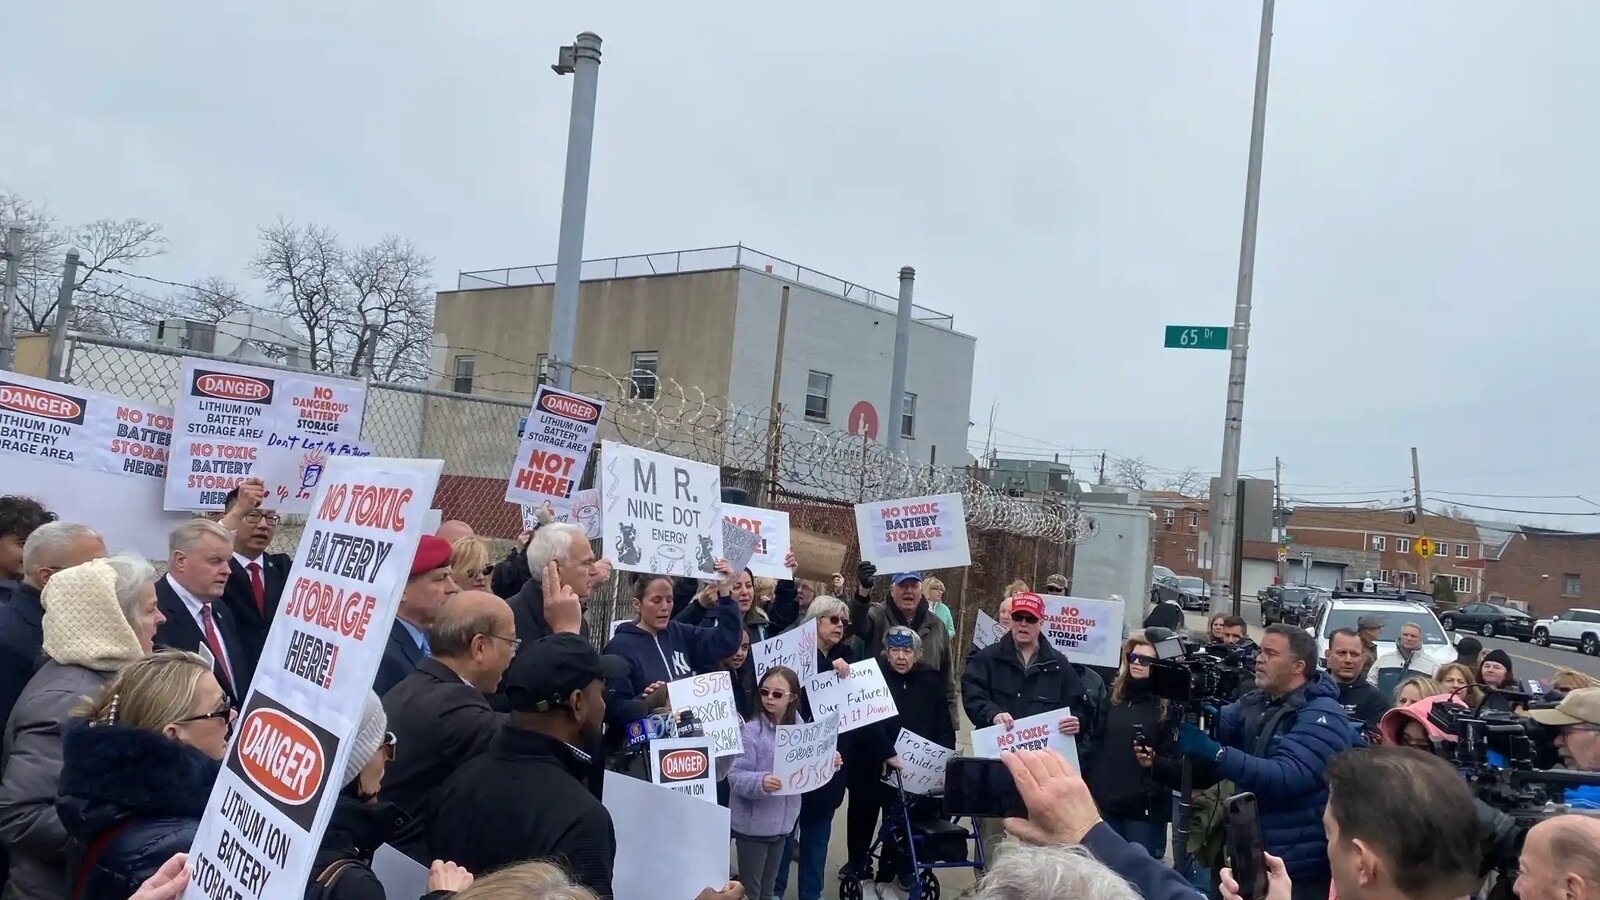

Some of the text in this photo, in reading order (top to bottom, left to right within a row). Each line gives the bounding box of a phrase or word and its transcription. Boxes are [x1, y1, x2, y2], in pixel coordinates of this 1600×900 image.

[1180, 328, 1213, 345] 65 Dr
[205, 378, 263, 397] DANGER
[314, 386, 333, 400] NO
[0, 388, 72, 416] DANGER
[199, 401, 262, 416] LITHIUM ION
[292, 397, 349, 413] DANGEROUS
[547, 396, 592, 418] DANGER
[117, 406, 143, 423] NO
[147, 412, 174, 431] TOX
[207, 413, 252, 426] BATTERY
[300, 409, 339, 422] BATTERY
[0, 413, 71, 436] ITHIUM ION
[188, 423, 237, 437] STORAGE
[297, 419, 339, 432] STORAGE
[540, 415, 588, 434] LITHIUM ION
[1, 427, 58, 446] BATTERY
[117, 423, 172, 447] BATTE
[544, 426, 579, 441] BATTERY
[111, 439, 170, 462] STORA
[528, 432, 587, 453] STORAGE AREA
[41, 446, 74, 461] AREA
[190, 443, 258, 460] NO TOXIC
[192, 459, 253, 475] BATTERY
[528, 448, 575, 477] NOT
[188, 474, 251, 490] STORAG
[515, 468, 575, 499] HERE!
[200, 491, 230, 505] HER
[317, 483, 414, 532] NO TOXIC
[627, 498, 701, 529] NINE DOT
[881, 502, 939, 519] NO TOXIC
[885, 515, 938, 531] BATTERY
[651, 528, 688, 544] ENERGY
[885, 526, 942, 543] STORAGE
[898, 540, 932, 553] HERE!
[304, 530, 393, 584] BATTERY
[285, 576, 376, 641] STORAGE
[1061, 606, 1079, 617] NO
[1043, 615, 1096, 626] DANGEROUS
[1050, 622, 1087, 634] BATTERY
[1048, 630, 1088, 642] STORAGE
[1055, 639, 1079, 648] HERE!
[764, 639, 783, 655] NO
[283, 630, 340, 689] HERE!
[630, 735, 646, 745] NTD
[996, 724, 1050, 747] NO TOXIC
[1001, 737, 1049, 753] ATTERY
[243, 716, 316, 796] DANGER
[785, 745, 814, 763] OUR
[901, 751, 946, 773] Childre
[666, 755, 703, 774] DANGER
[693, 784, 705, 796] ION
[220, 785, 291, 870] LITHIUM ION
[217, 829, 271, 900] BATTERY
